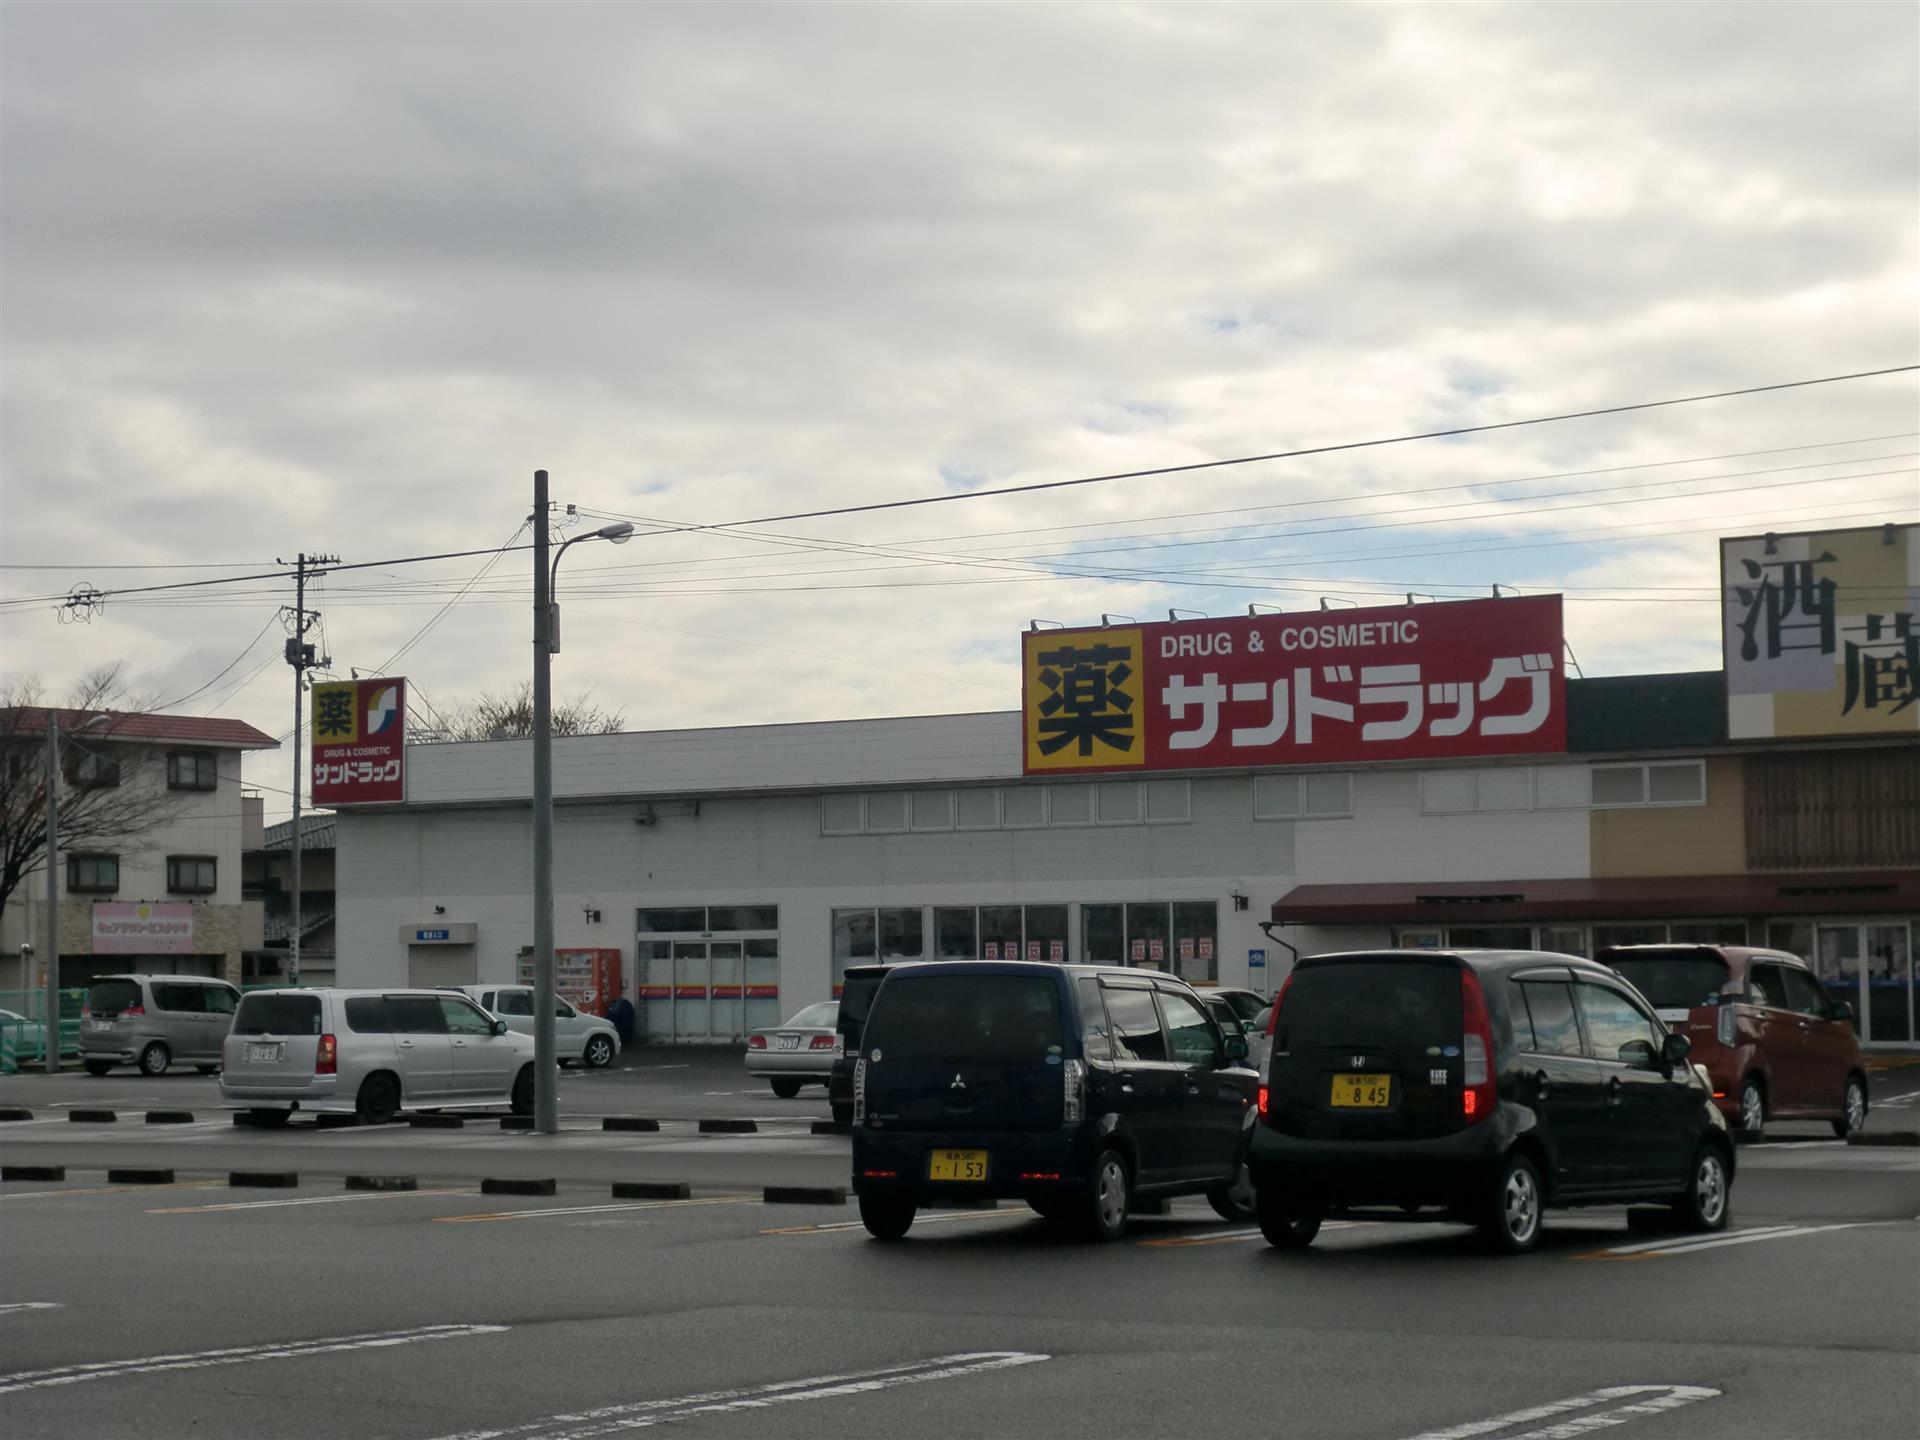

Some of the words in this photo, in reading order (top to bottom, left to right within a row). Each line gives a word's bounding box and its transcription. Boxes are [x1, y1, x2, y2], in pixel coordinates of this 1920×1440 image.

[1160, 632, 1233, 659] DRUG
[1247, 630, 1265, 653] &
[1280, 619, 1419, 652] COSMETIC
[318, 690, 352, 736] 薬
[1037, 644, 1135, 757] 薬
[1162, 652, 1554, 751] サンドラッグ
[314, 759, 400, 785] サンドラッグ
[323, 749, 345, 758] DRUG
[346, 748, 352, 757] &
[353, 746, 391, 757] COSMETIC
